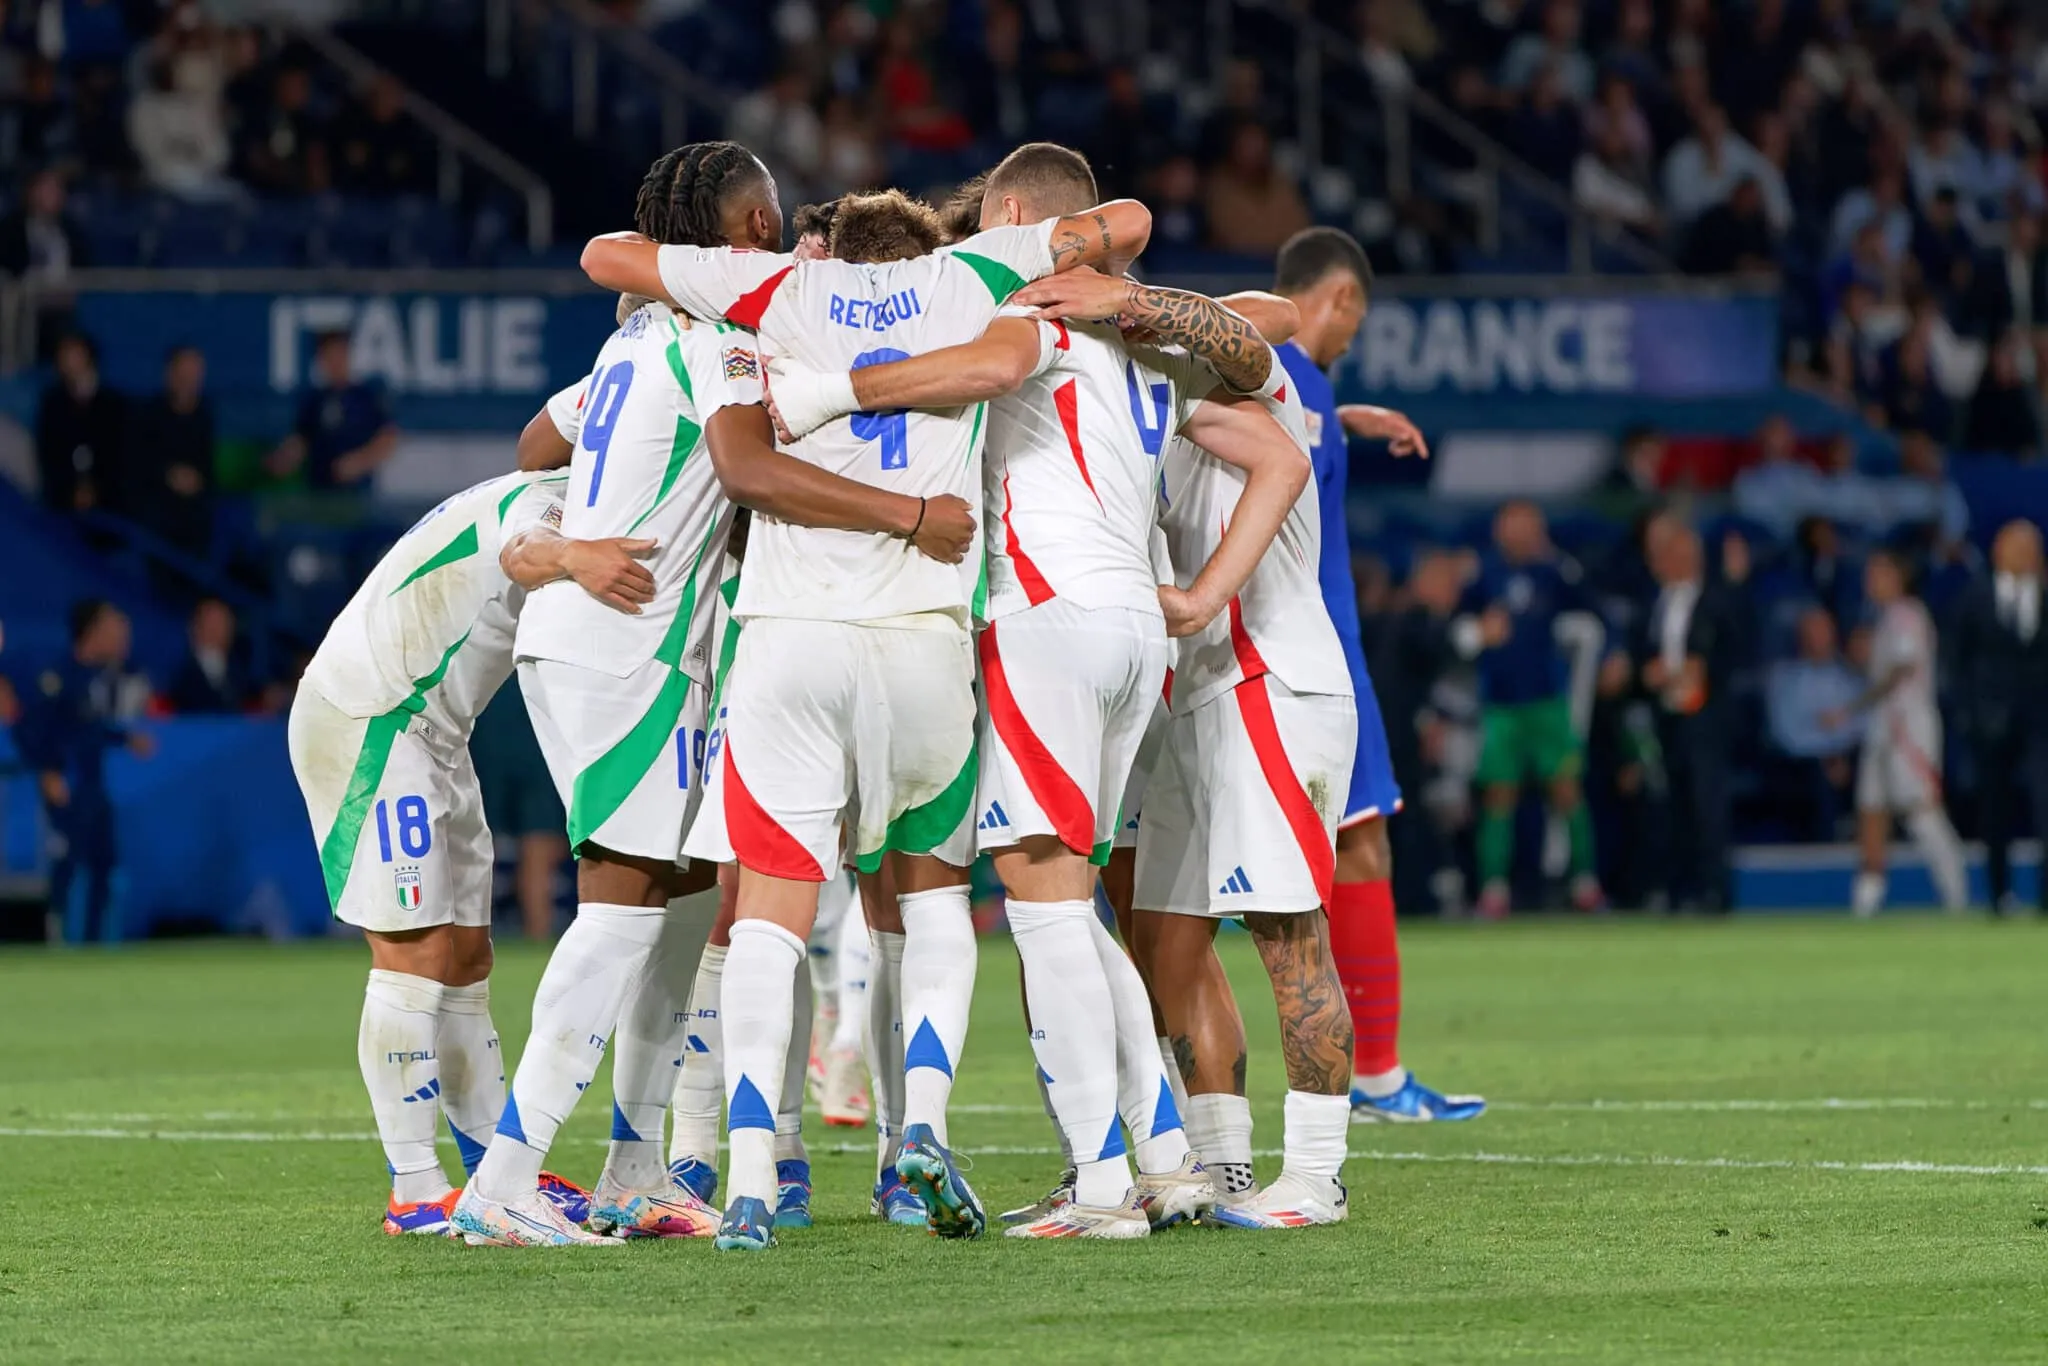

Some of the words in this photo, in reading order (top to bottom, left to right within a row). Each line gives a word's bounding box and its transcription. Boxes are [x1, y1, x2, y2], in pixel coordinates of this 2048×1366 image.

[829, 287, 921, 331] RETEGUI
[1331, 302, 1633, 391] RANCE
[848, 347, 908, 470] 9
[376, 795, 431, 863] 18
